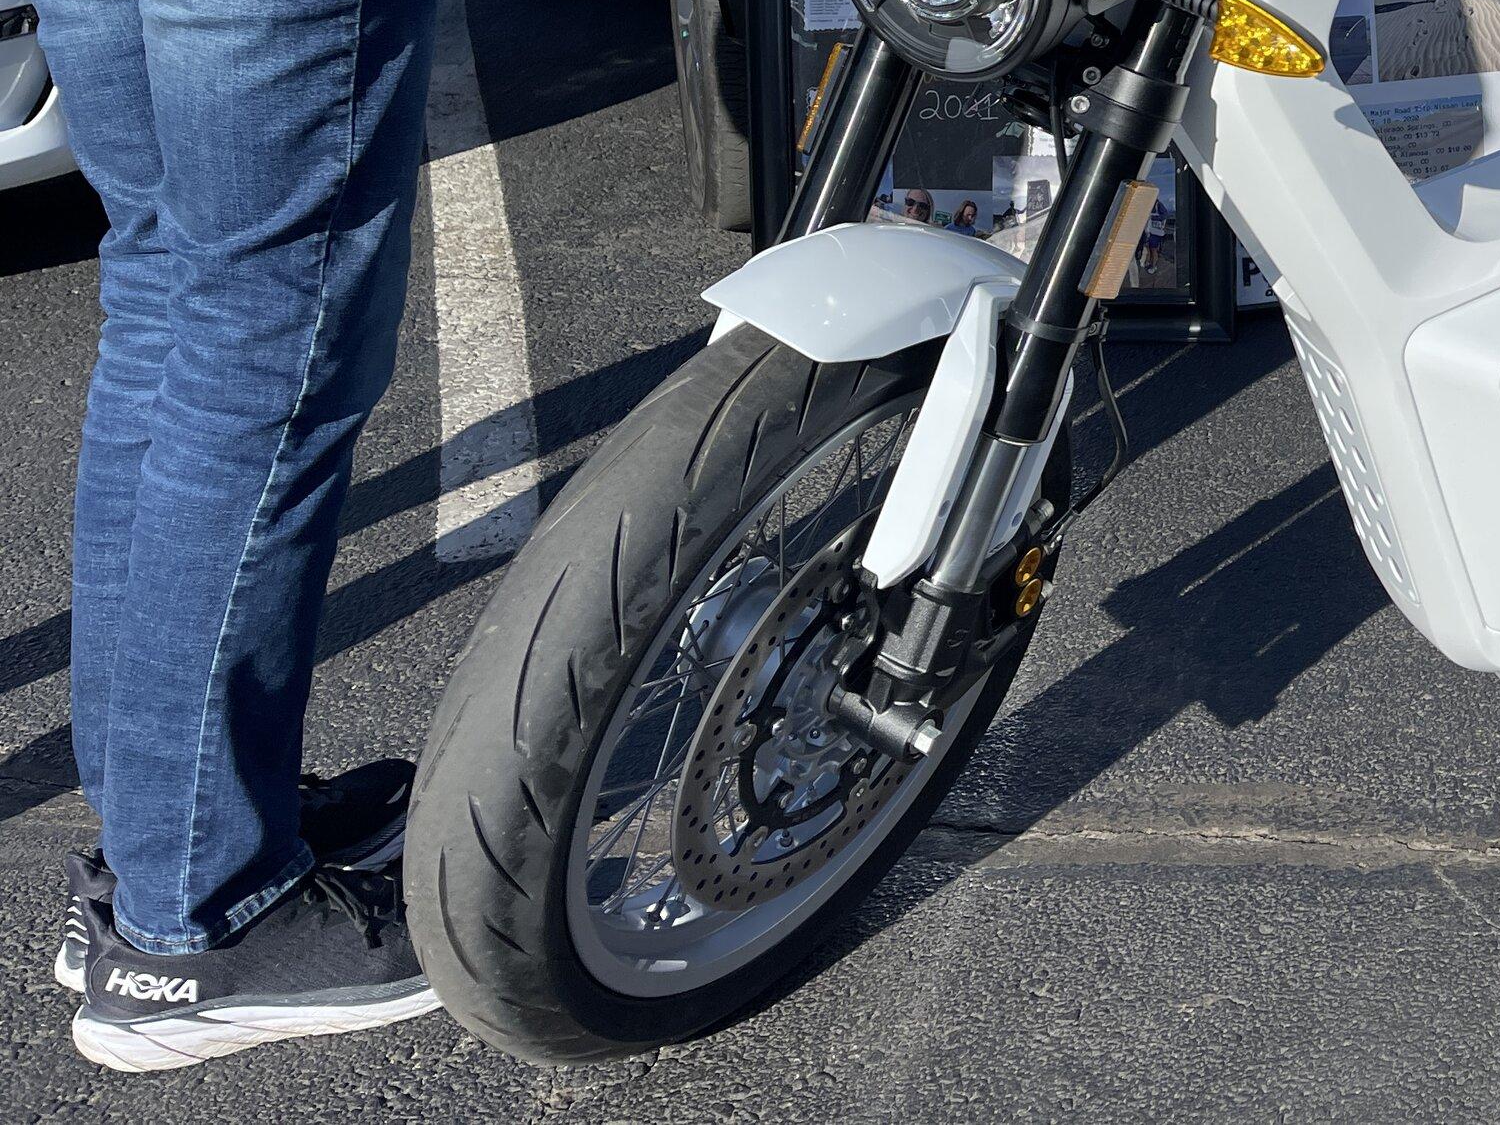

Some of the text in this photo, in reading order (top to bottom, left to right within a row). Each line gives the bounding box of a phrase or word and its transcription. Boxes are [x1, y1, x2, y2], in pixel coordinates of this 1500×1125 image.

[1395, 106, 1411, 114] Road
[1376, 124, 1405, 134] olorado
[104, 967, 199, 1003] HOKA
